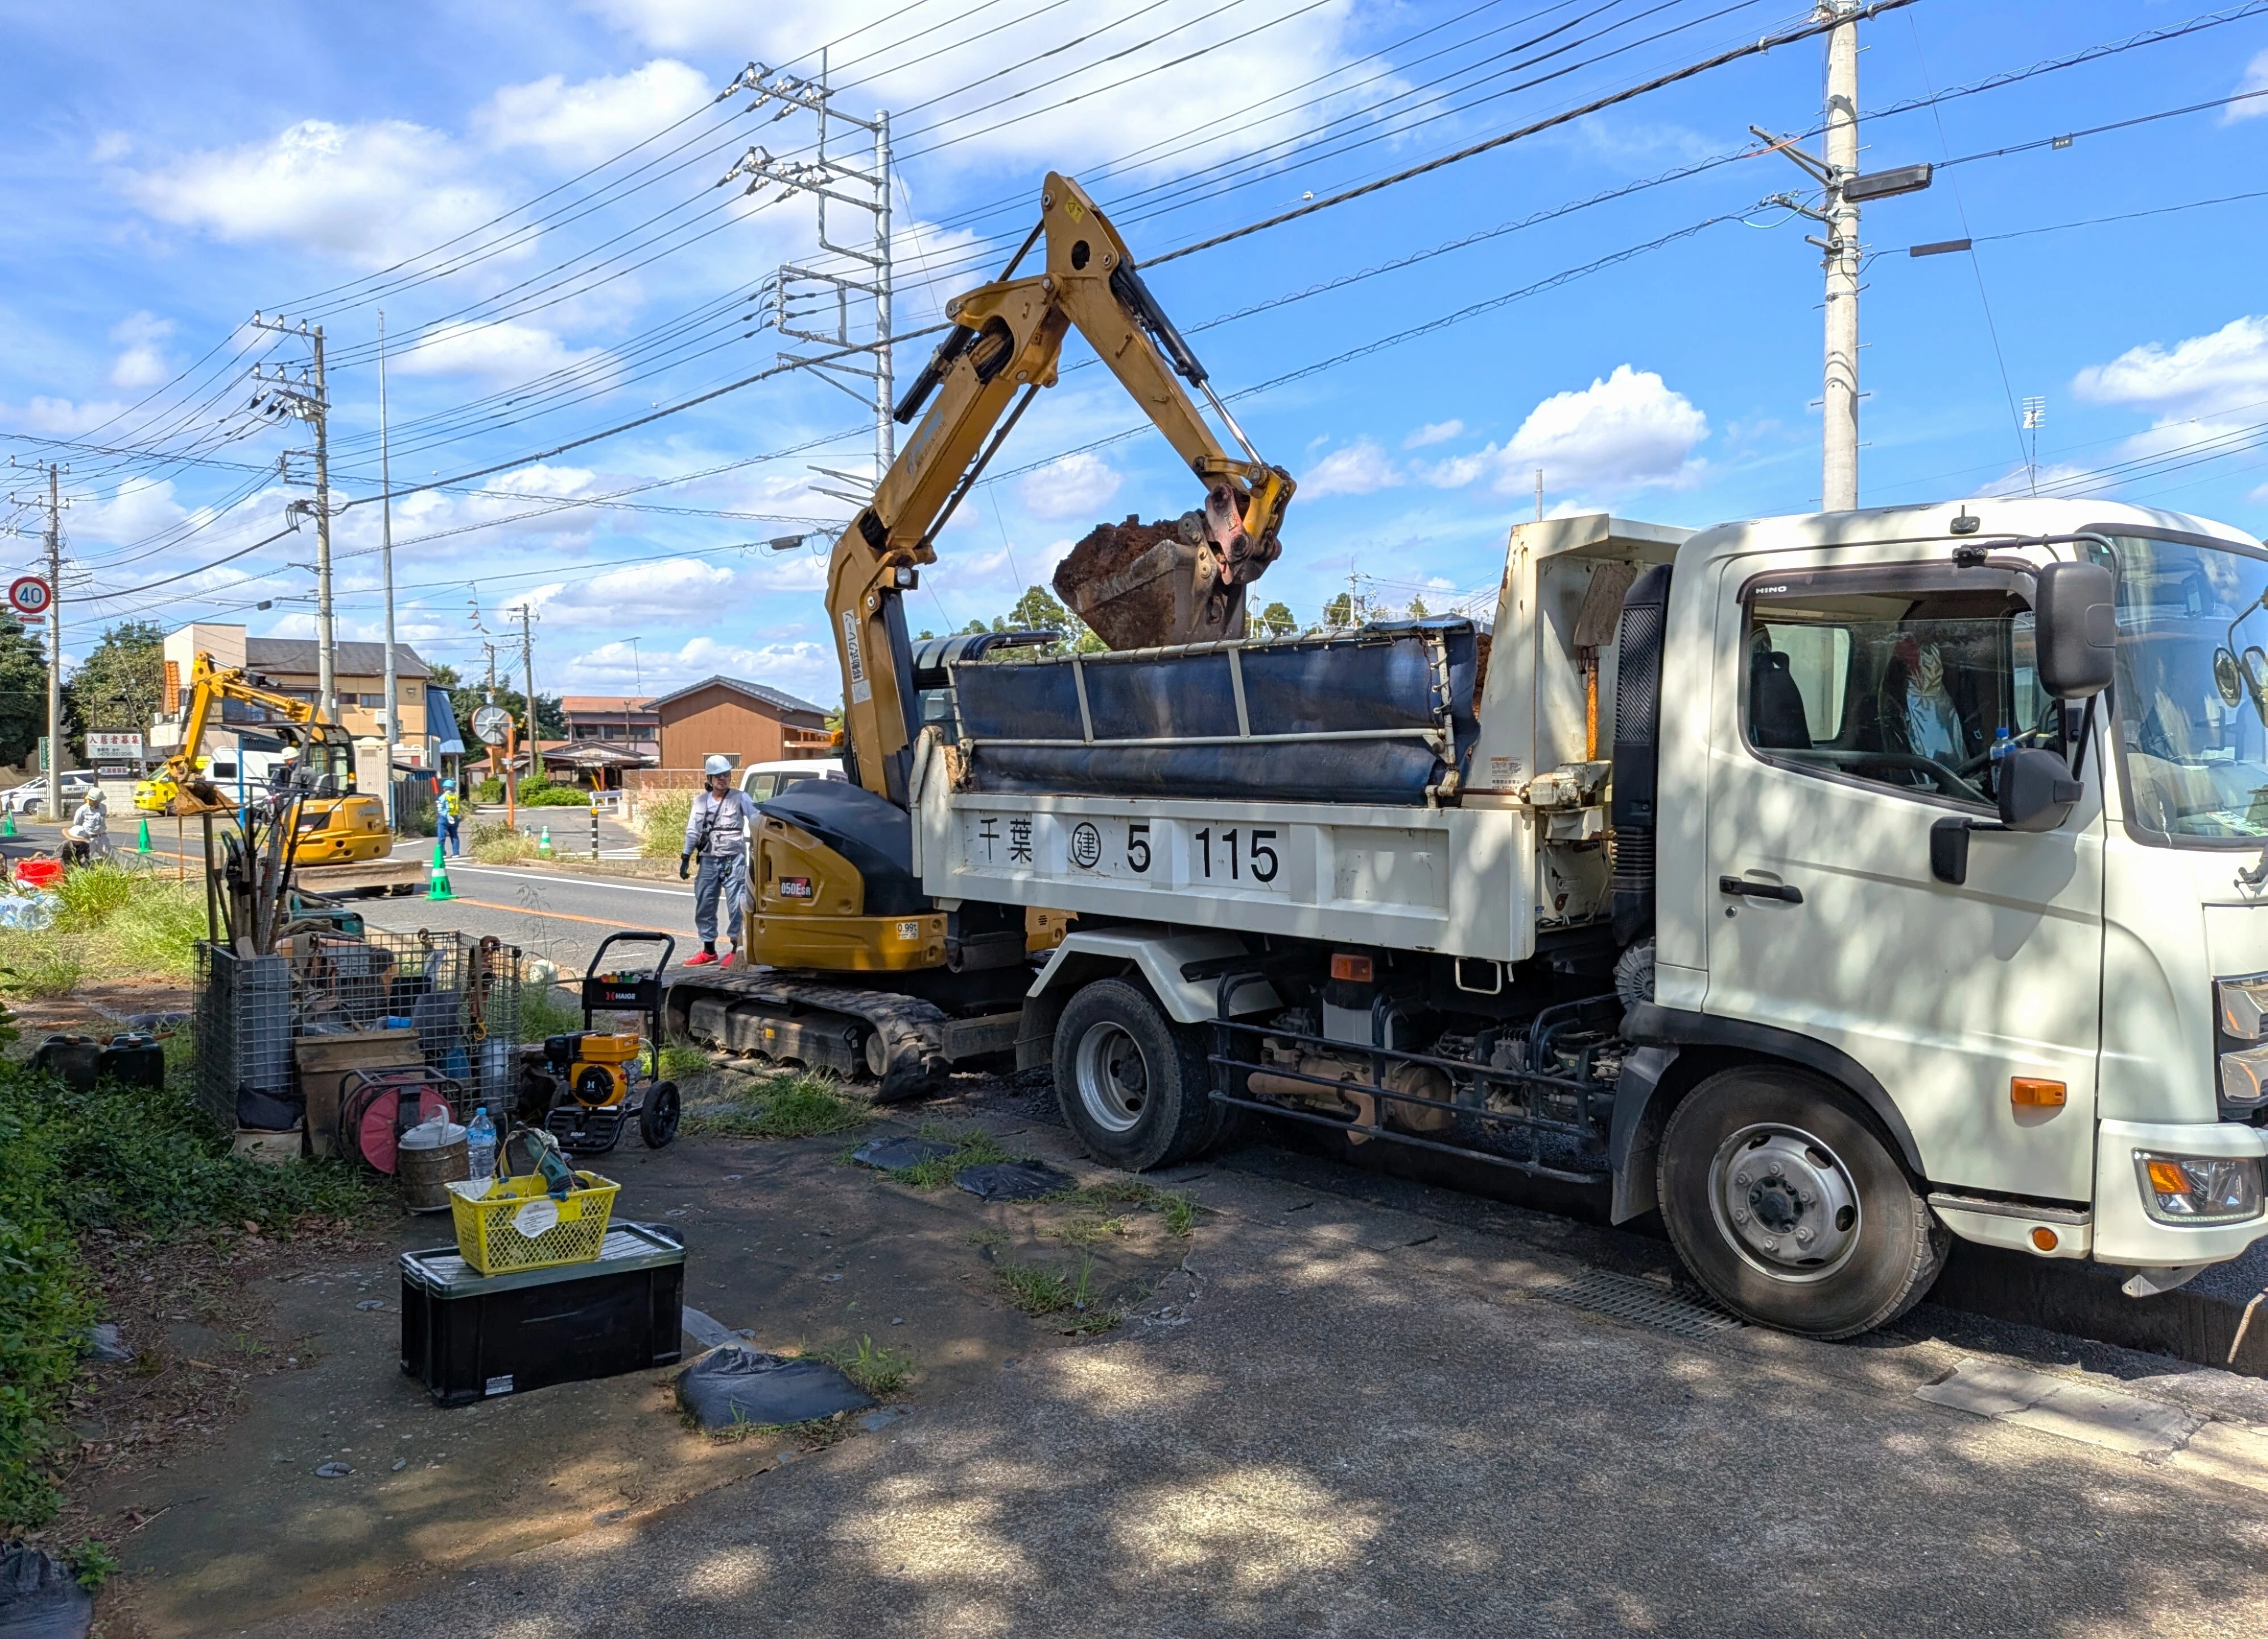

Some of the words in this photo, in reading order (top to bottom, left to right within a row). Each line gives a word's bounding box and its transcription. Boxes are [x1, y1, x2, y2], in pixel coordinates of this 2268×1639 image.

[19, 587, 42, 604] 40
[845, 613, 862, 680] 移動式クレーン
[89, 735, 139, 745] 入居者募集
[979, 818, 1032, 864] 千葉
[1127, 824, 1150, 873] 5
[1195, 827, 1278, 882] 115
[898, 923, 917, 932] 0.99t
